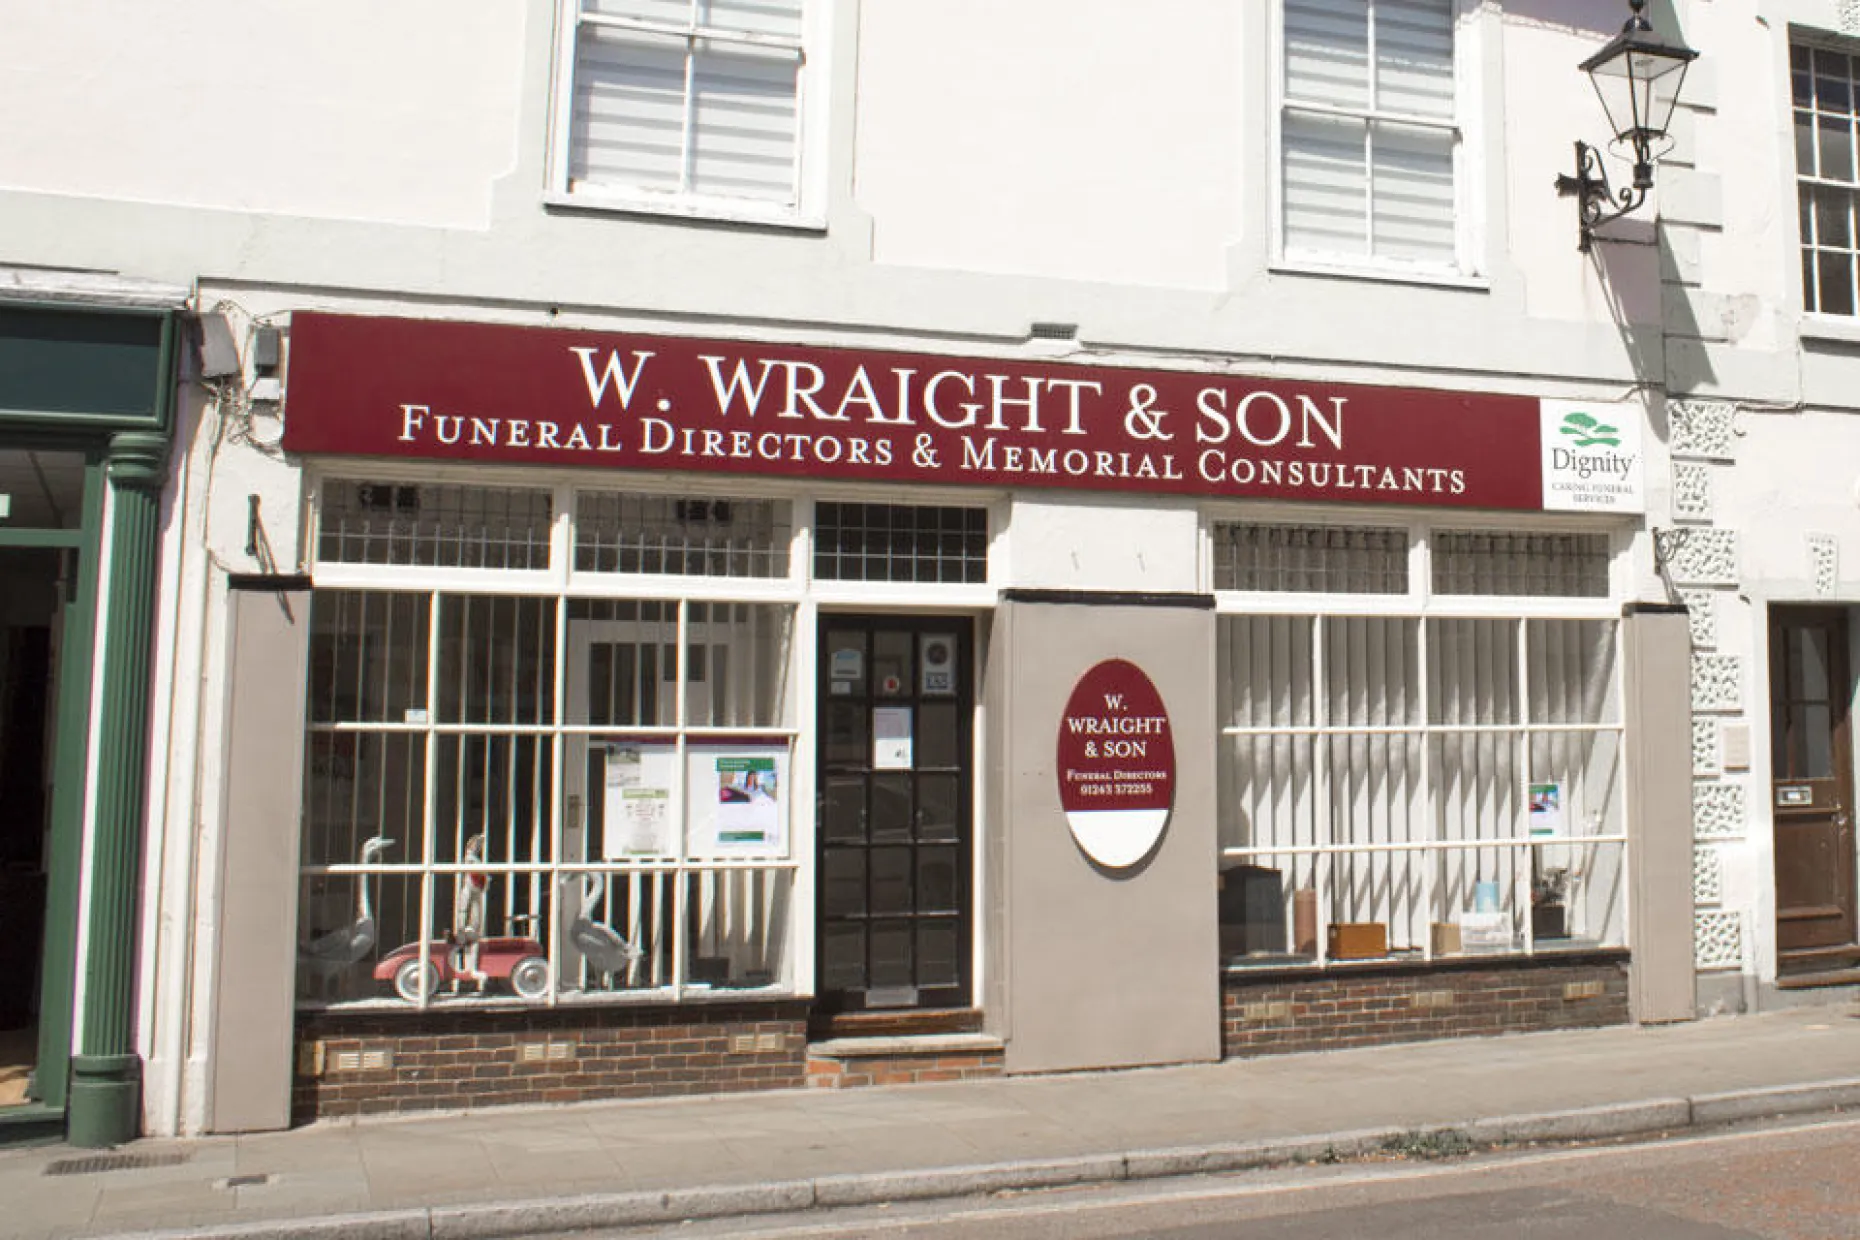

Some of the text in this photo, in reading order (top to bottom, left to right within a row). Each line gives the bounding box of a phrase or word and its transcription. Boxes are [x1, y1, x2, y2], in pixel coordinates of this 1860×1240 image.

[569, 346, 1349, 451] W. WRAIGHT & SON
[398, 404, 1466, 495] FUNERAL DIRECTORS & MEMORIAL CONSULTANTS
[1551, 447, 1634, 480] Dignity
[1104, 693, 1128, 711] W.
[1068, 717, 1165, 734] WRAIGHT
[1085, 740, 1147, 758] & SON
